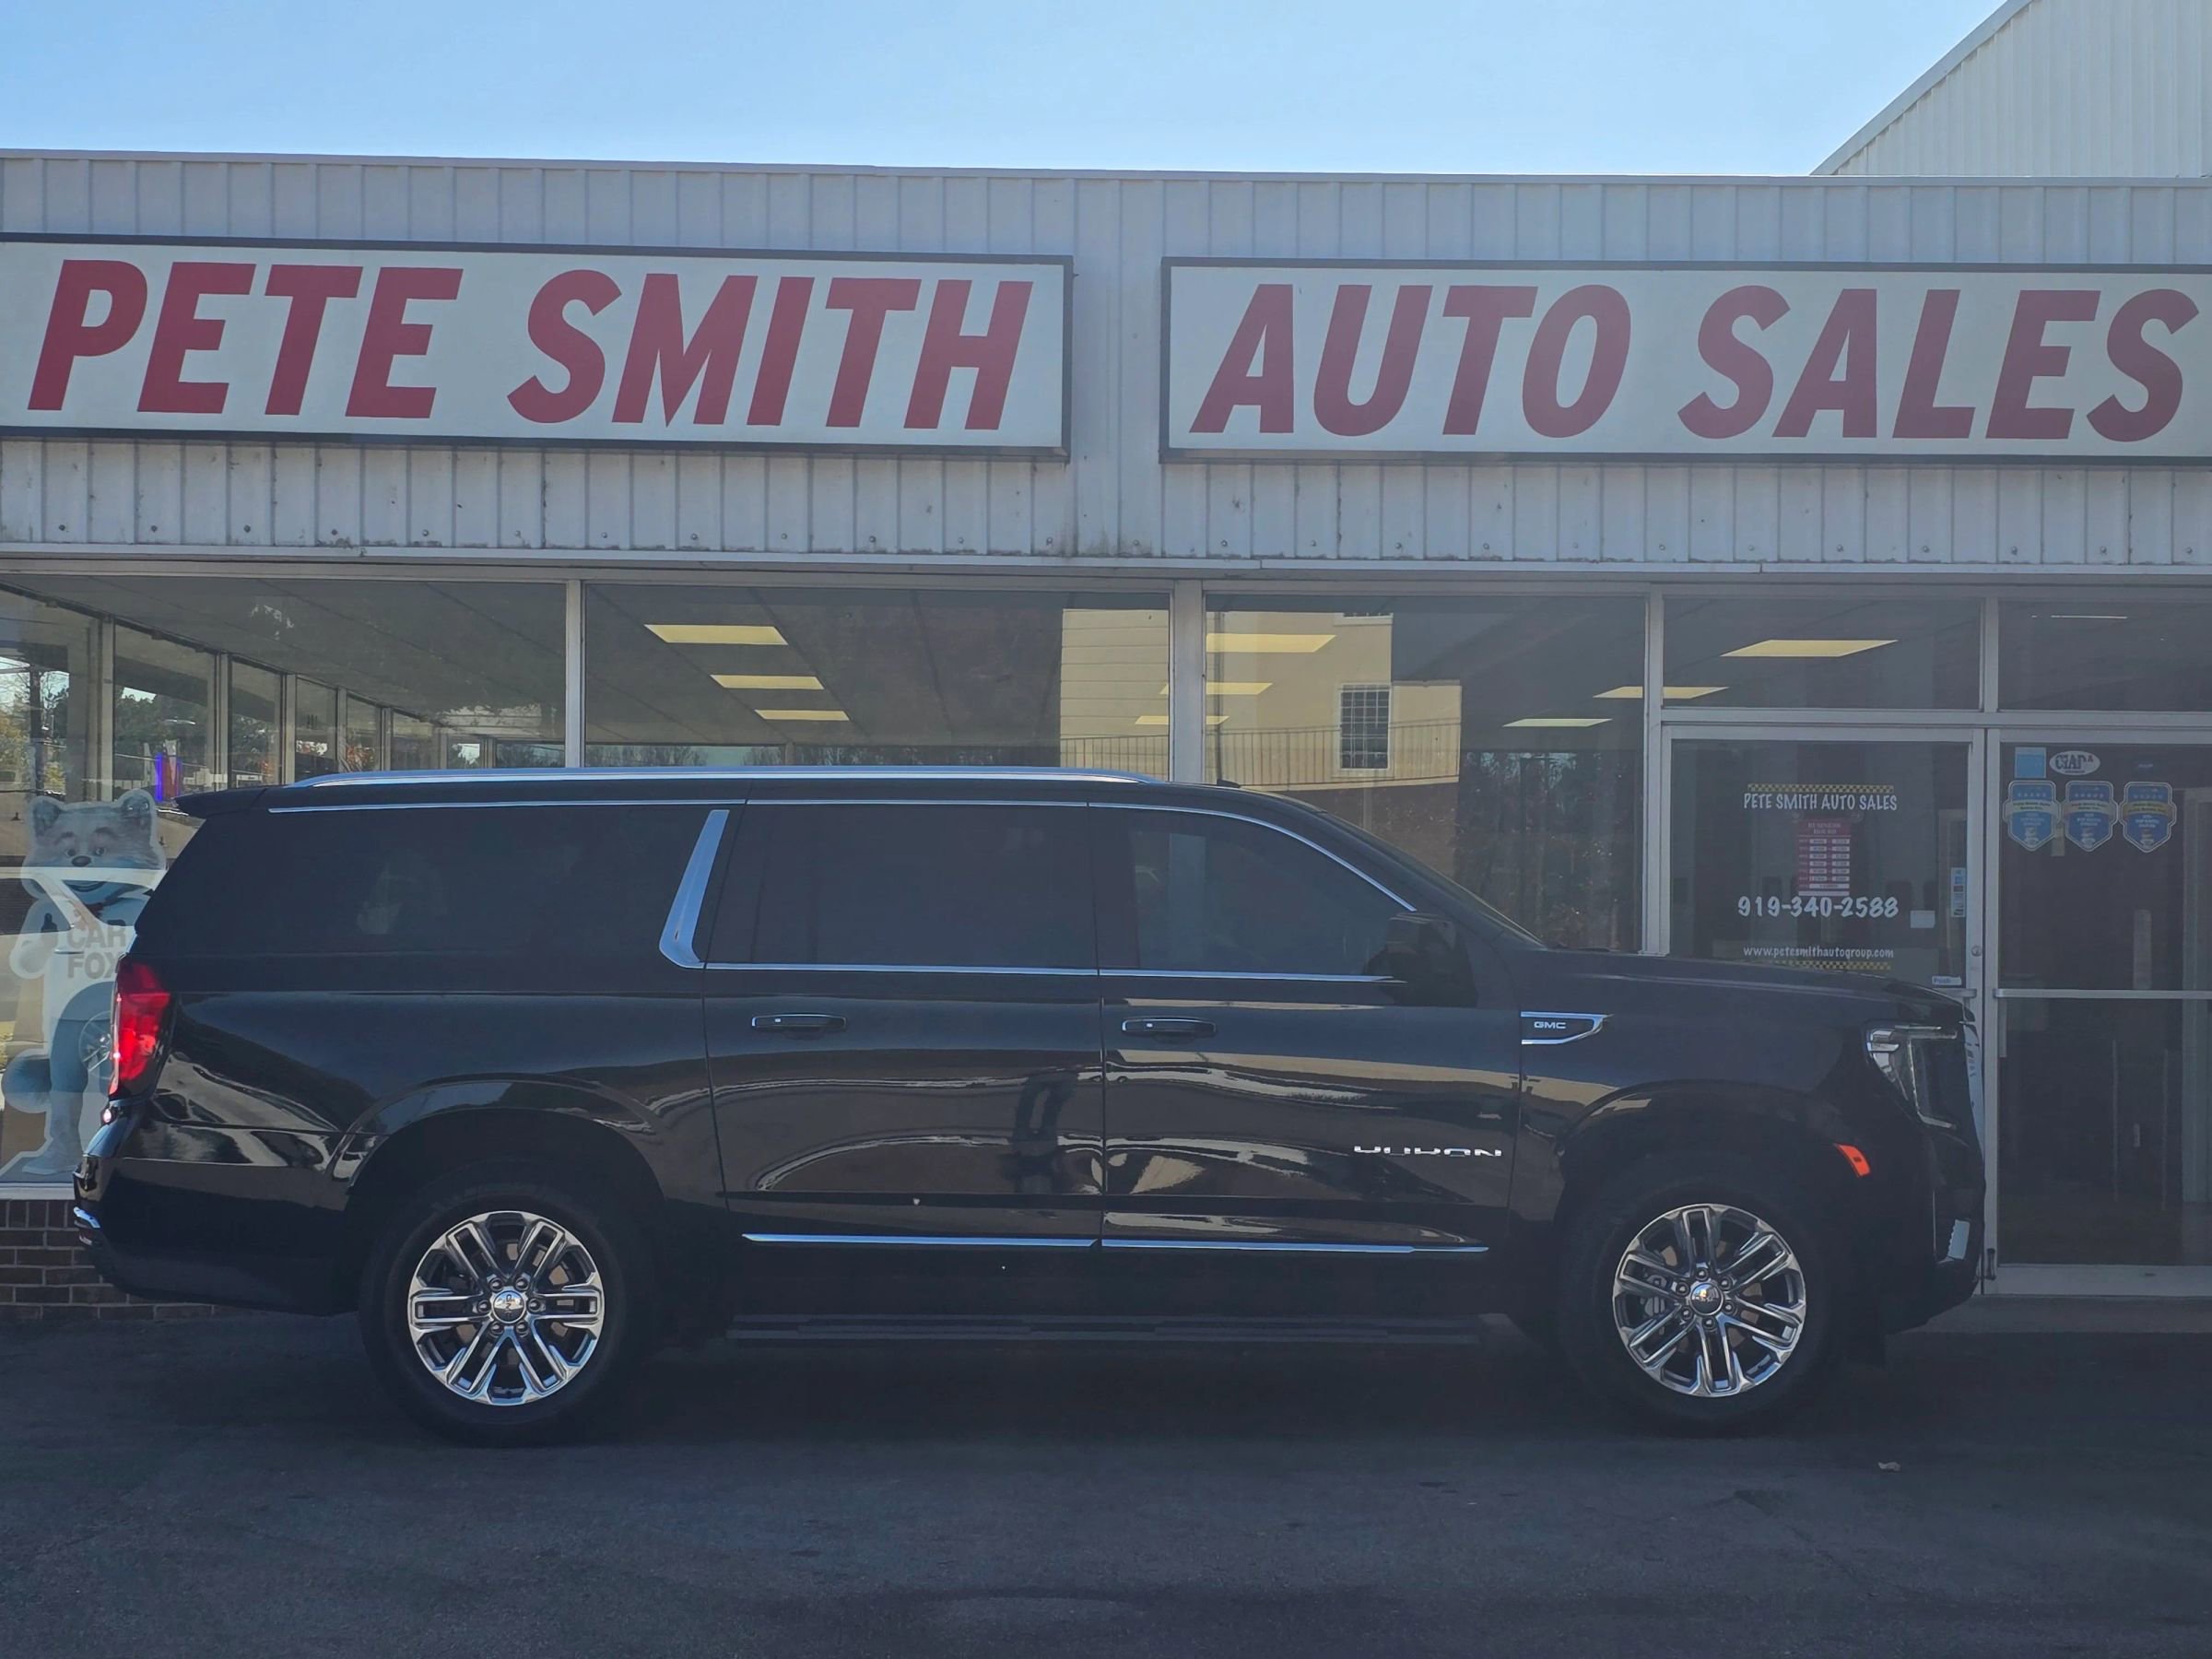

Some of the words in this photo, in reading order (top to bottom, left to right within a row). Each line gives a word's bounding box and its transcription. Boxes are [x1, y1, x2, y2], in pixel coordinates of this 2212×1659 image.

[27, 259, 464, 418] PETE
[506, 269, 1034, 430] SMITH
[1188, 284, 1631, 438] AUTO
[1677, 285, 2200, 442] SALES
[1744, 793, 1771, 809] PETE
[1776, 794, 1818, 809] SMITH
[1821, 794, 1855, 810] AUTO
[1859, 794, 1898, 811] SALES
[1737, 896, 1899, 918] 919-340-2588
[66, 925, 126, 948] CAR
[1743, 946, 1894, 959] www.petesmithautogroup.com
[1534, 1021, 1567, 1030] GMC
